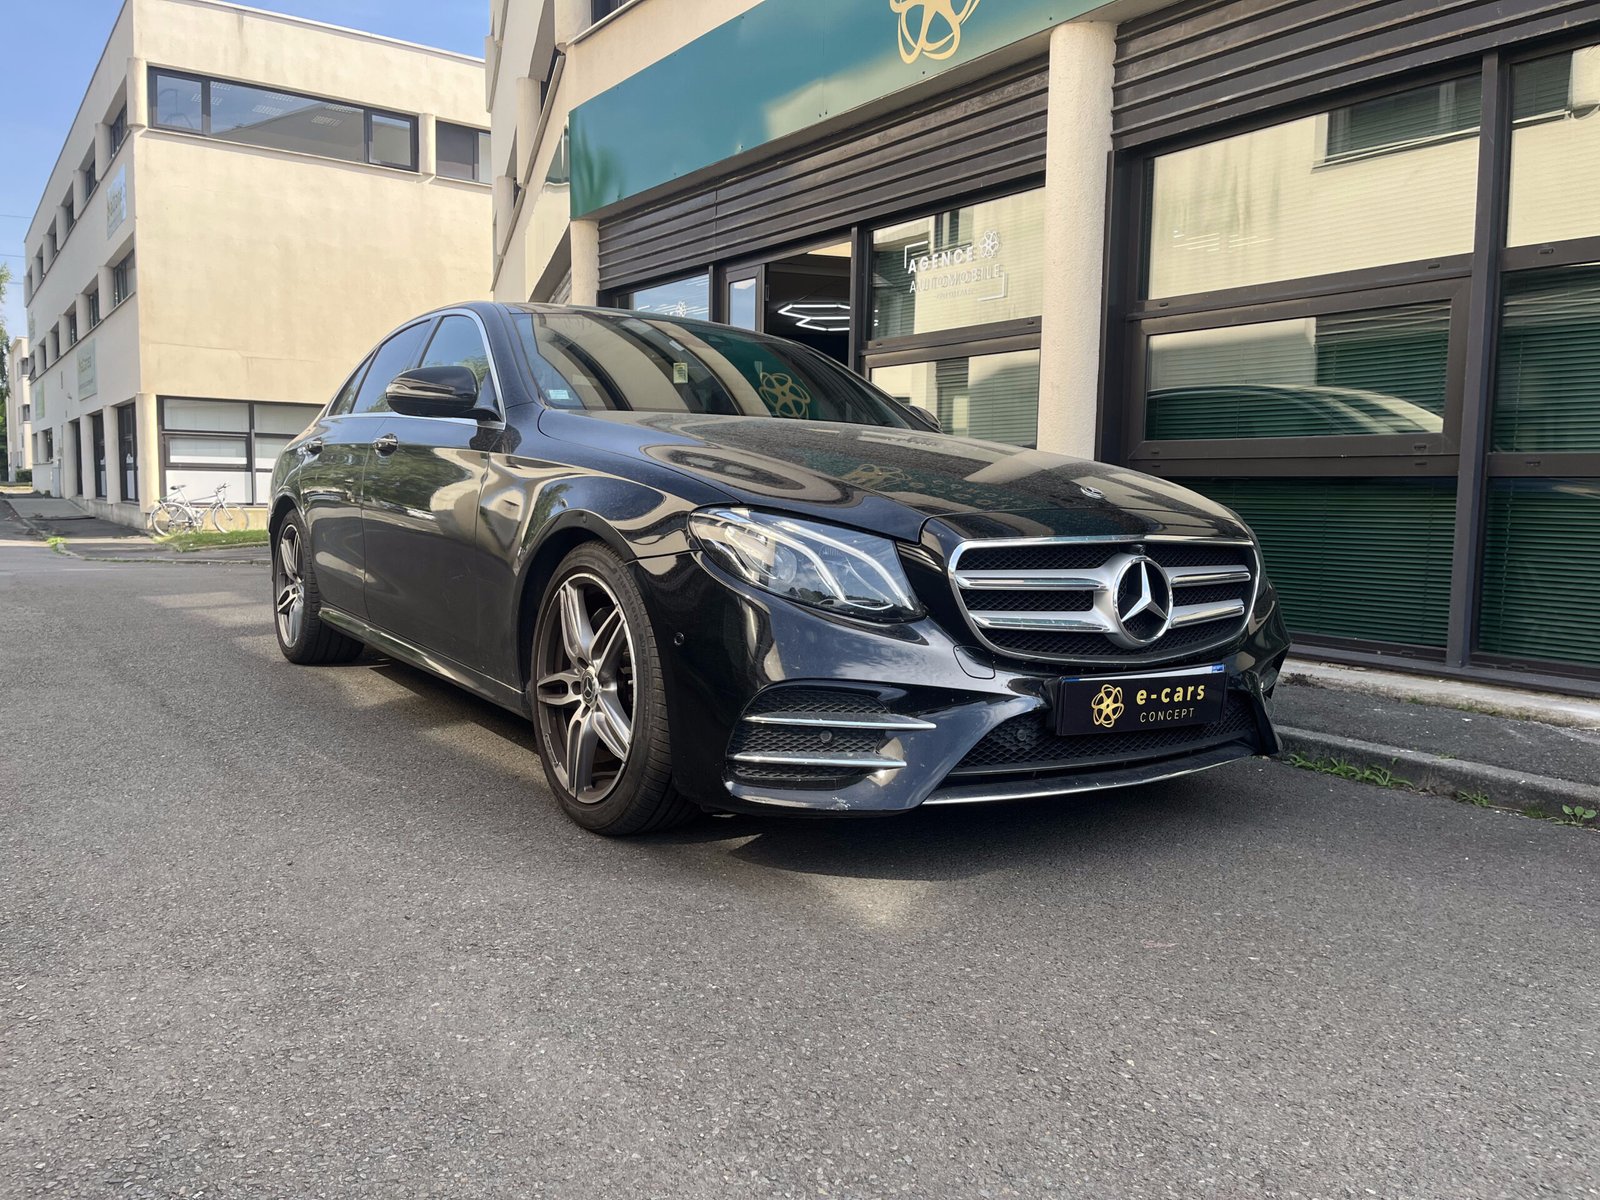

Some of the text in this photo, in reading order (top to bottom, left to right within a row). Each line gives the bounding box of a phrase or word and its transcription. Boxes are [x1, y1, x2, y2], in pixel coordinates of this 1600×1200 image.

[908, 246, 974, 274] AGENCE
[909, 263, 1001, 293] AUTOMOBILE
[1136, 684, 1205, 705] e-cars
[1139, 707, 1195, 723] CONCEPT
